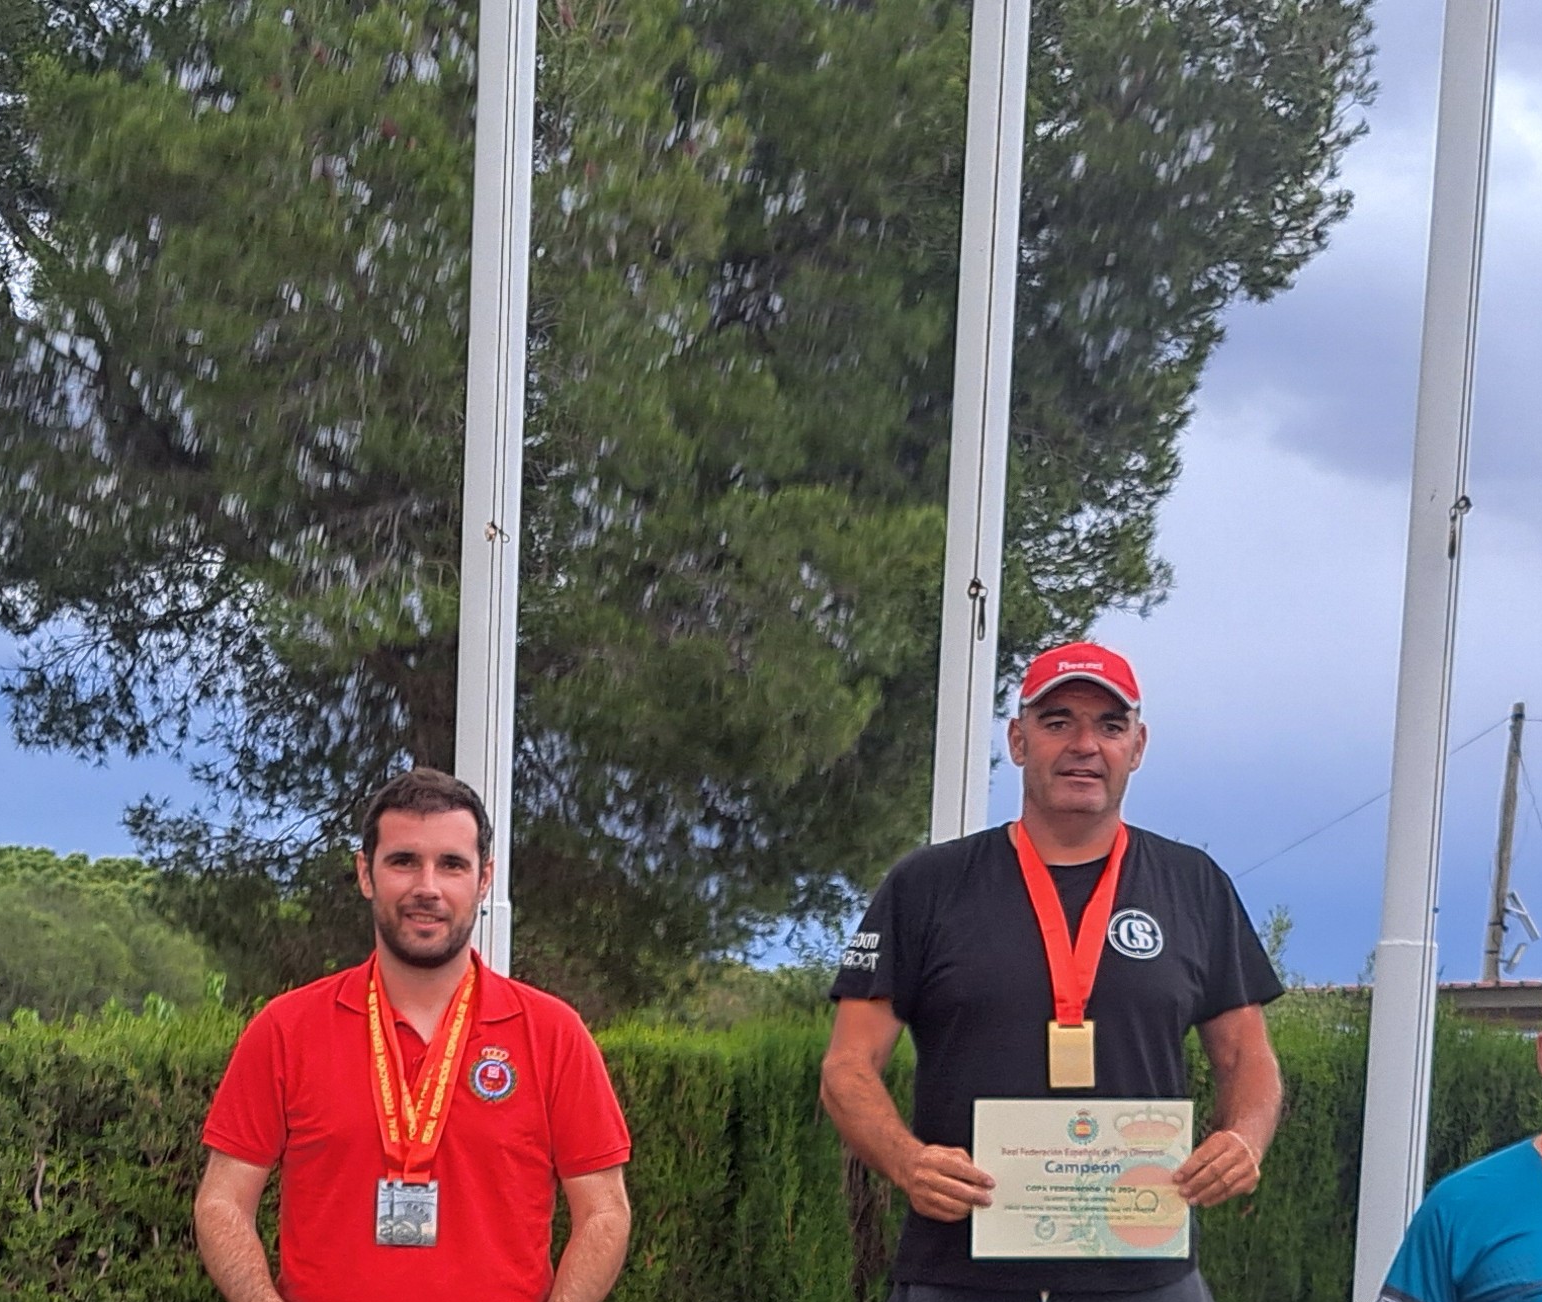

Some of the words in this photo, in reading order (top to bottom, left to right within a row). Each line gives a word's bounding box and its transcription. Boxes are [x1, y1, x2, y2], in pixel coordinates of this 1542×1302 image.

[368, 1004, 384, 1054] ESPAÑOLA
[444, 1013, 464, 1058] ESPAÑOLA
[376, 1054, 395, 1116] FEDERACIÓN
[429, 1058, 453, 1118] FEDERACIÓN
[388, 1117, 400, 1143] REAL
[421, 1119, 438, 1144] REAL
[1002, 1147, 1018, 1155] Real
[1044, 1160, 1121, 1177] Campeón
